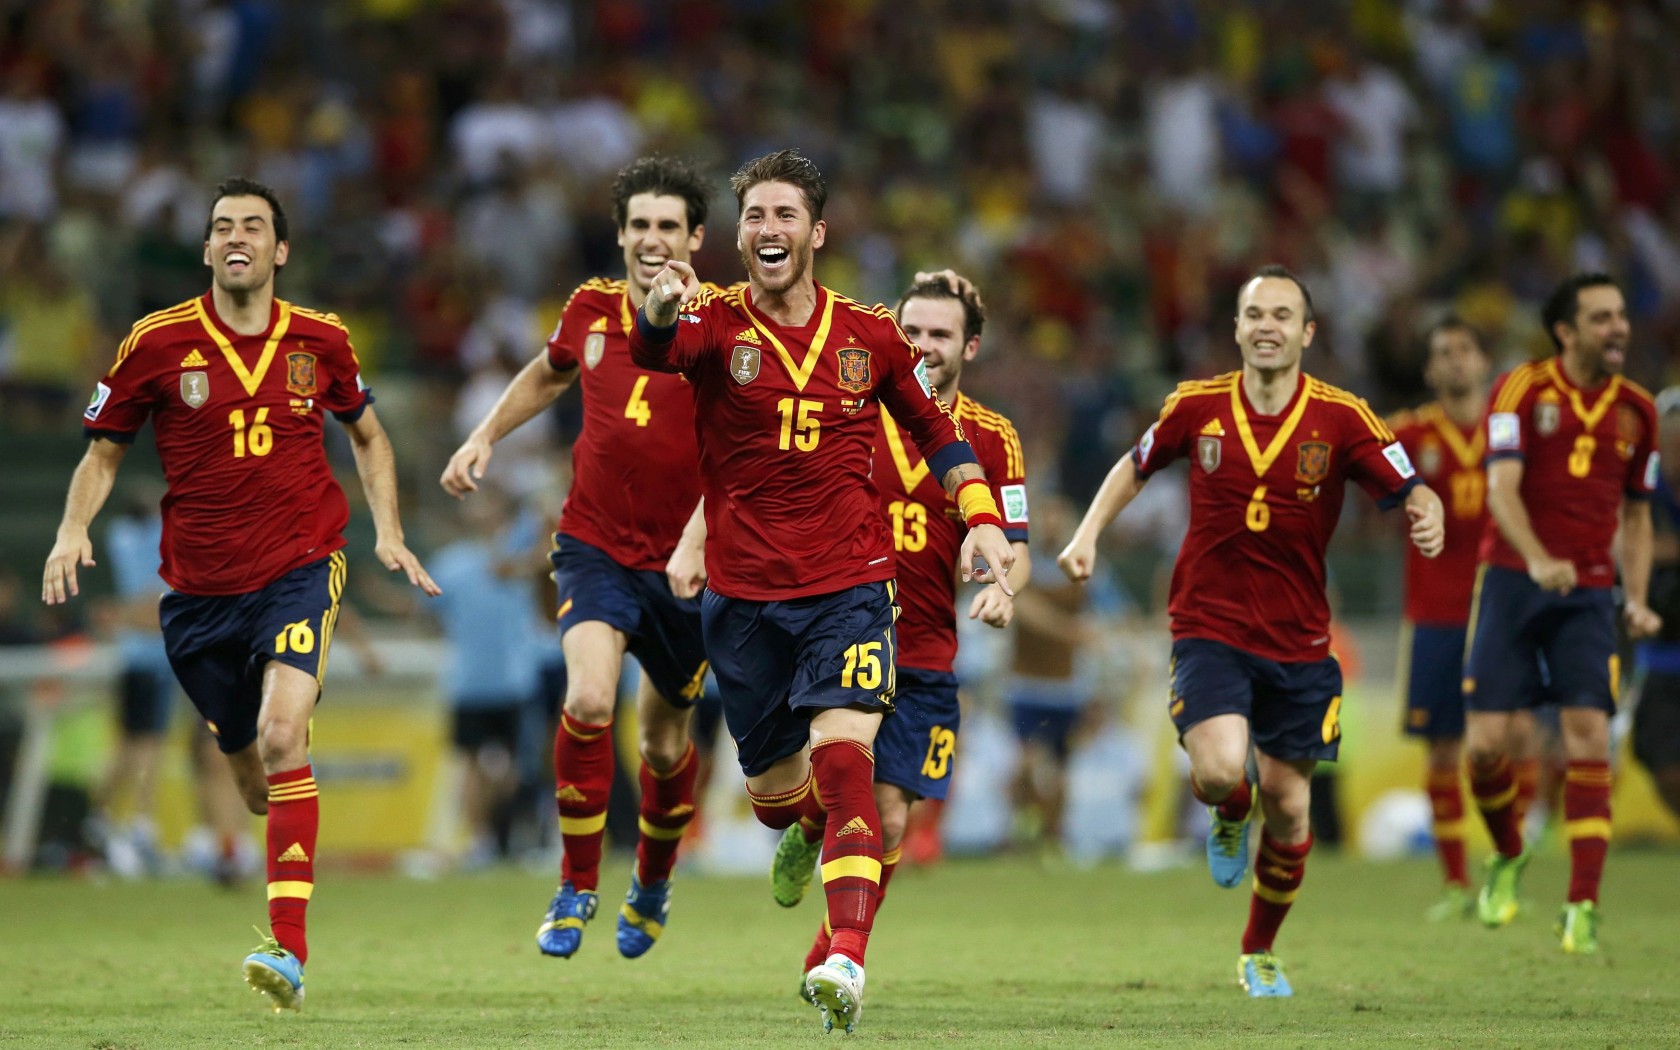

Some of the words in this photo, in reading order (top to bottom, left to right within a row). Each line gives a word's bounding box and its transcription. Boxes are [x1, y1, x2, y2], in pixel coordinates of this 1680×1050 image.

[735, 335, 762, 346] adidas
[624, 375, 651, 426] 4
[777, 398, 824, 452] 15
[229, 407, 273, 457] 16
[1568, 436, 1595, 478] 8
[888, 501, 928, 552] 13
[1246, 486, 1270, 531] 6
[841, 642, 882, 690] 15
[921, 725, 956, 780] 13
[836, 827, 873, 837] adidas
